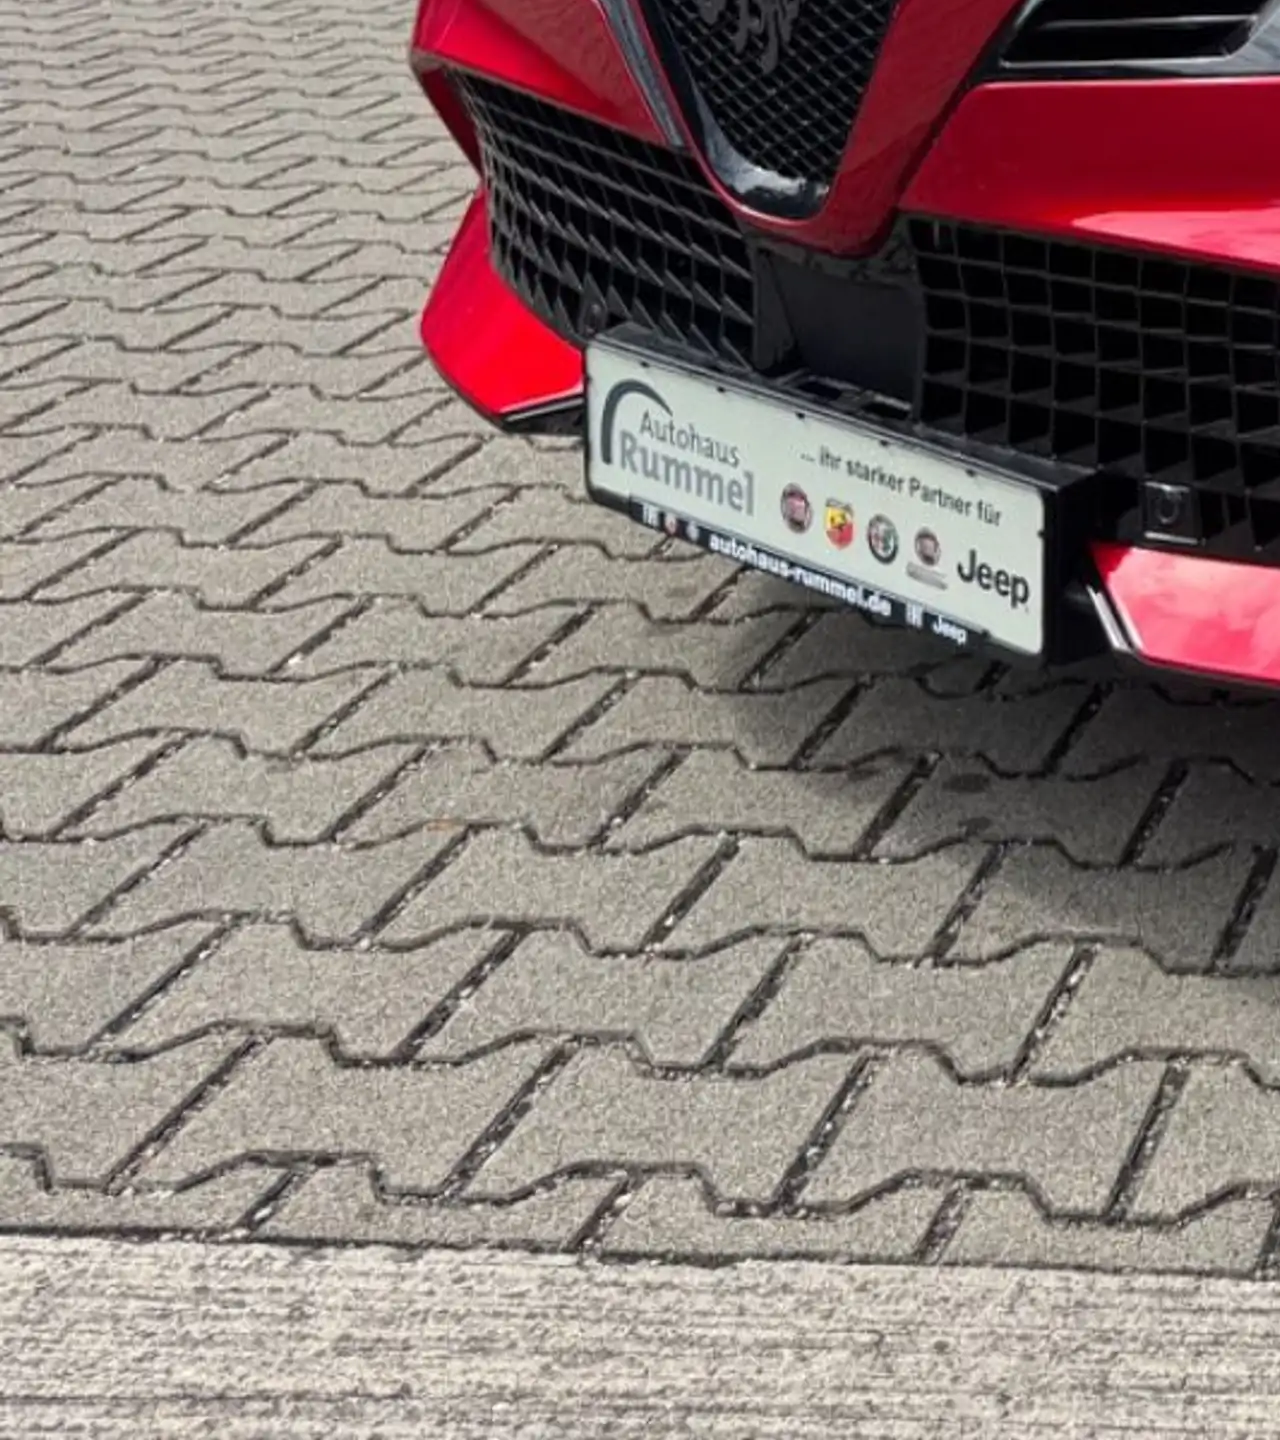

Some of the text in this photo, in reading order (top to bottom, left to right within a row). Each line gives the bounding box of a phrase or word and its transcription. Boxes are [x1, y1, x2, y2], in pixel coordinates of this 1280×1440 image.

[640, 409, 740, 468] Autohaus
[620, 429, 754, 517] Rummel
[846, 459, 904, 494] starker
[908, 476, 971, 517] Partner
[977, 498, 1002, 527] für
[709, 533, 892, 617] autohaus-rummel.de
[932, 615, 967, 645] Jeep
[957, 548, 1030, 608] Jeep
